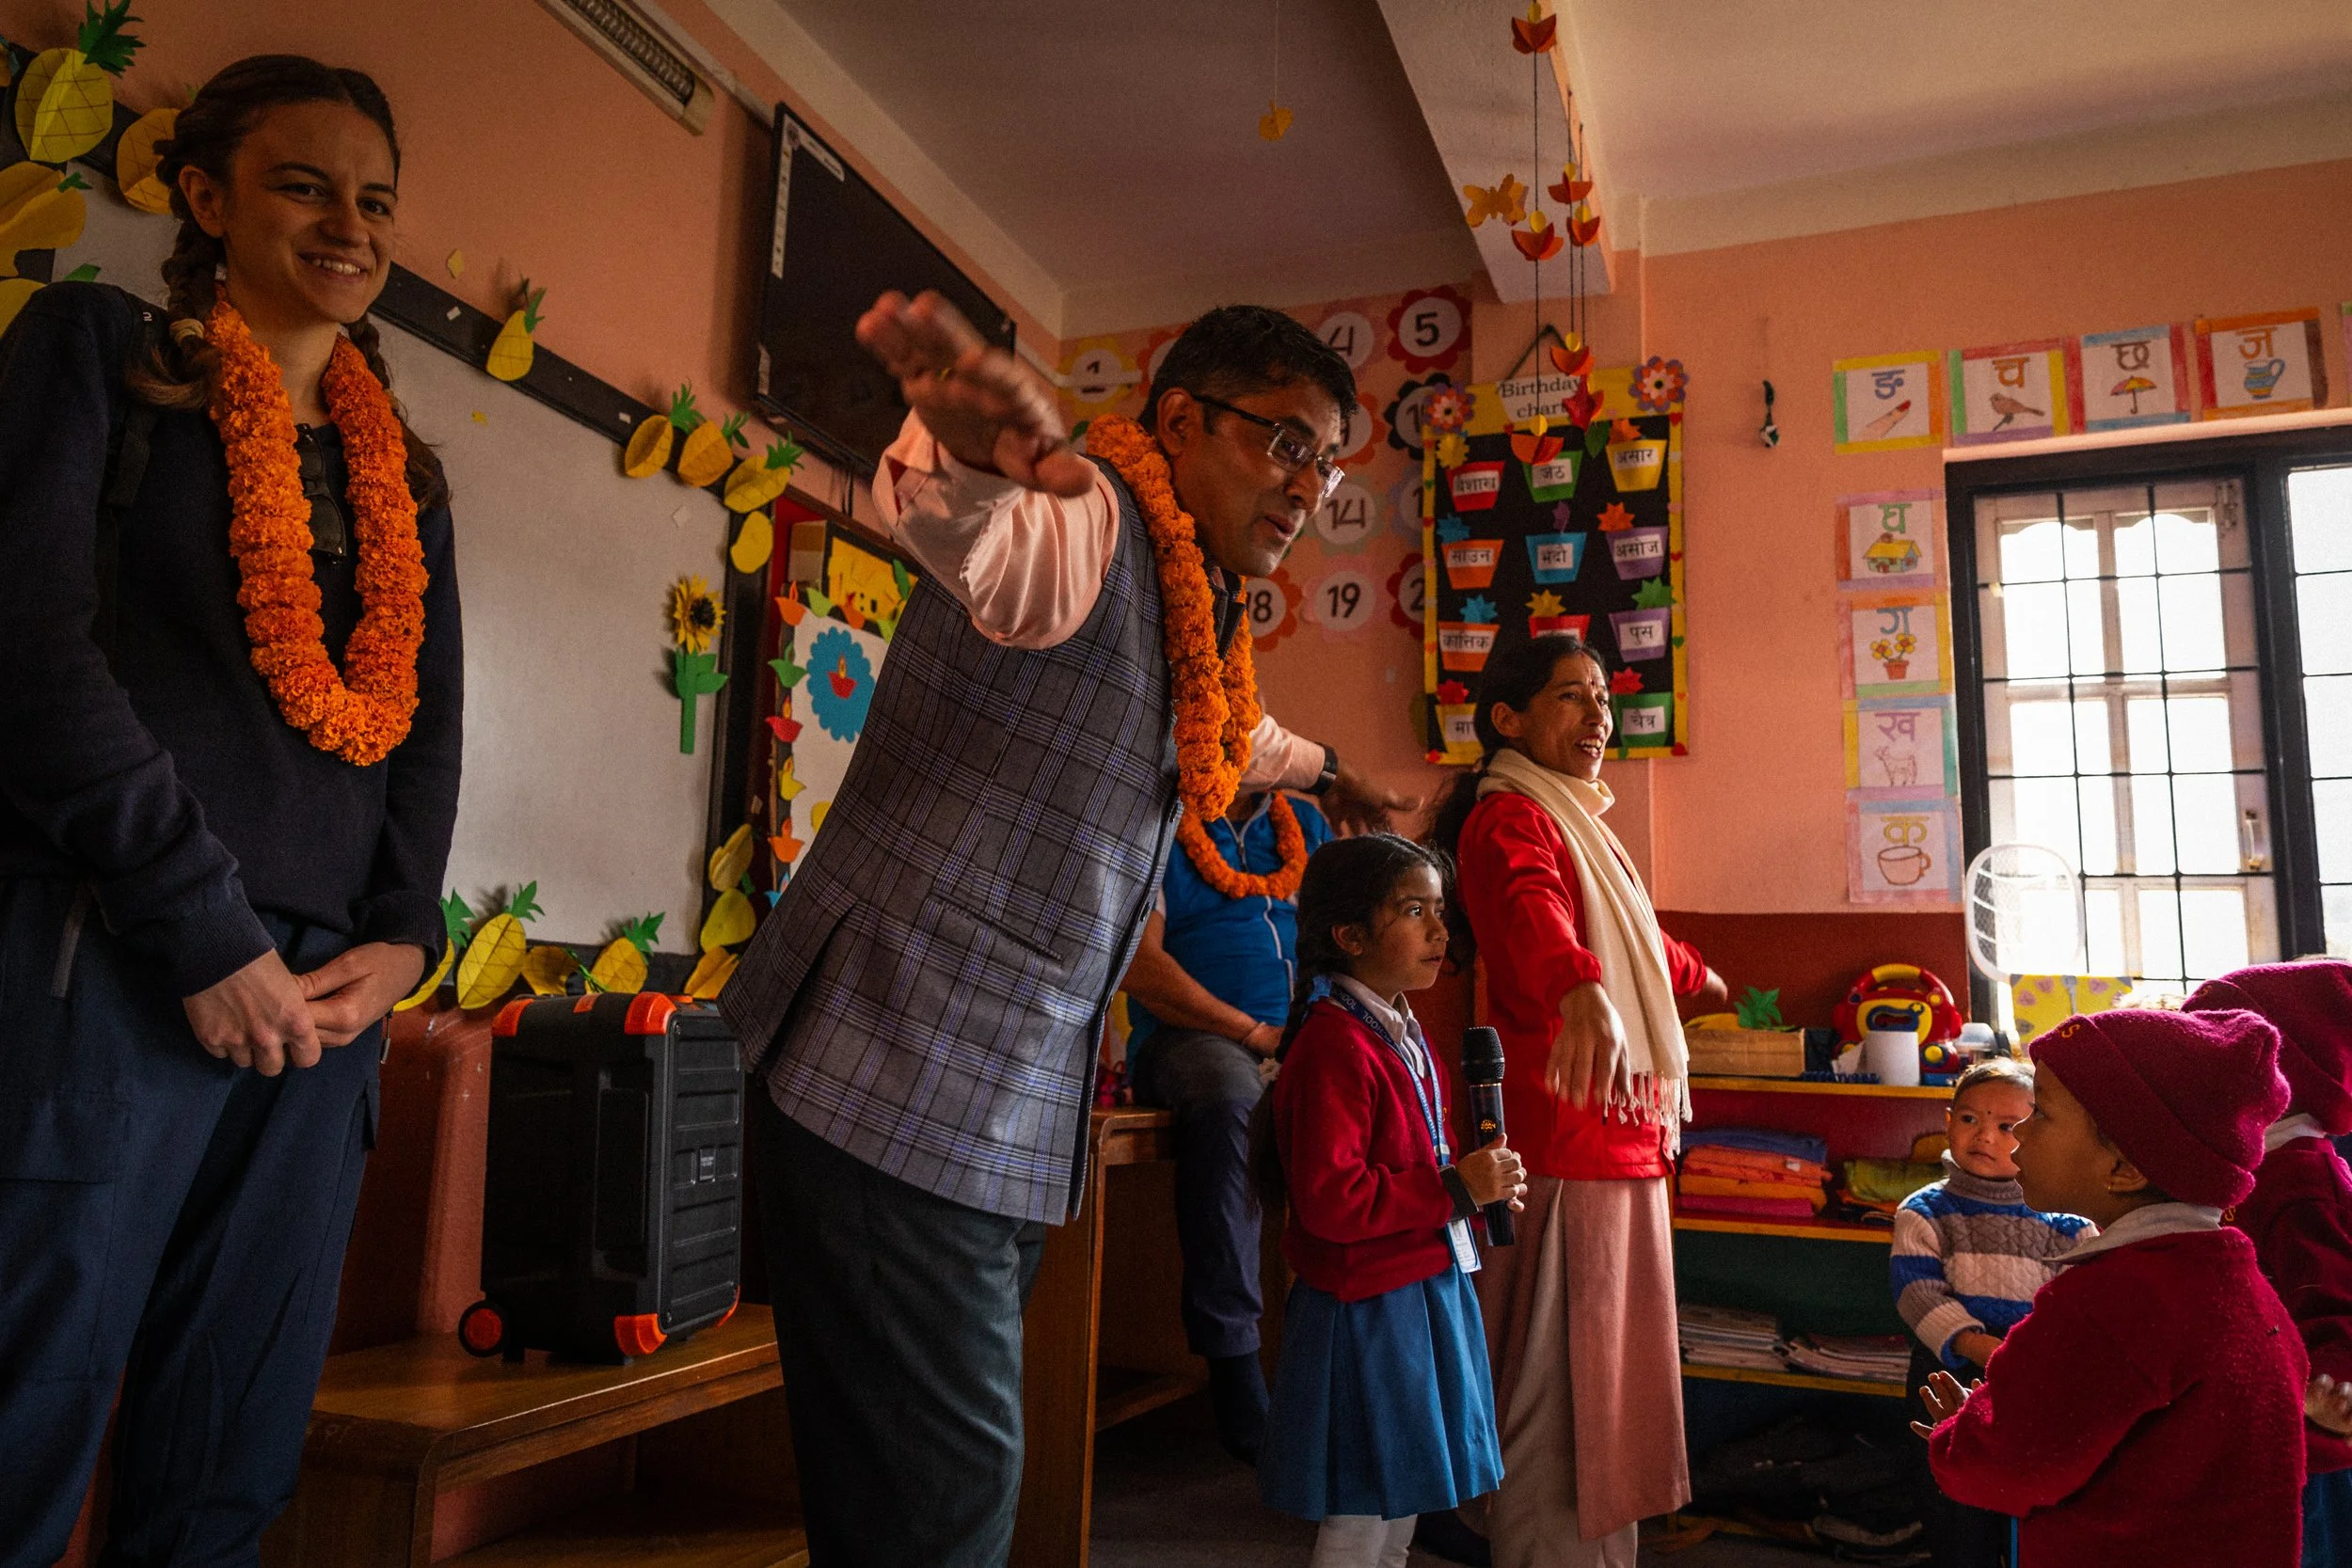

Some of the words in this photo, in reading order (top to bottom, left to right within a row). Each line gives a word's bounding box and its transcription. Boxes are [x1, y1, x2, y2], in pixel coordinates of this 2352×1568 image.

[1328, 325, 1355, 356] 4
[1415, 312, 1440, 347] 5
[2234, 326, 2278, 359] ज
[2110, 341, 2151, 371] छ
[1871, 369, 1905, 400] ङ
[1992, 356, 2030, 388] च
[1326, 499, 1366, 531] 14
[1878, 502, 1913, 534] घ
[1327, 581, 1361, 618] 19
[1876, 606, 1914, 635] ग
[1874, 711, 1920, 742] ख
[1881, 816, 1930, 846] क
